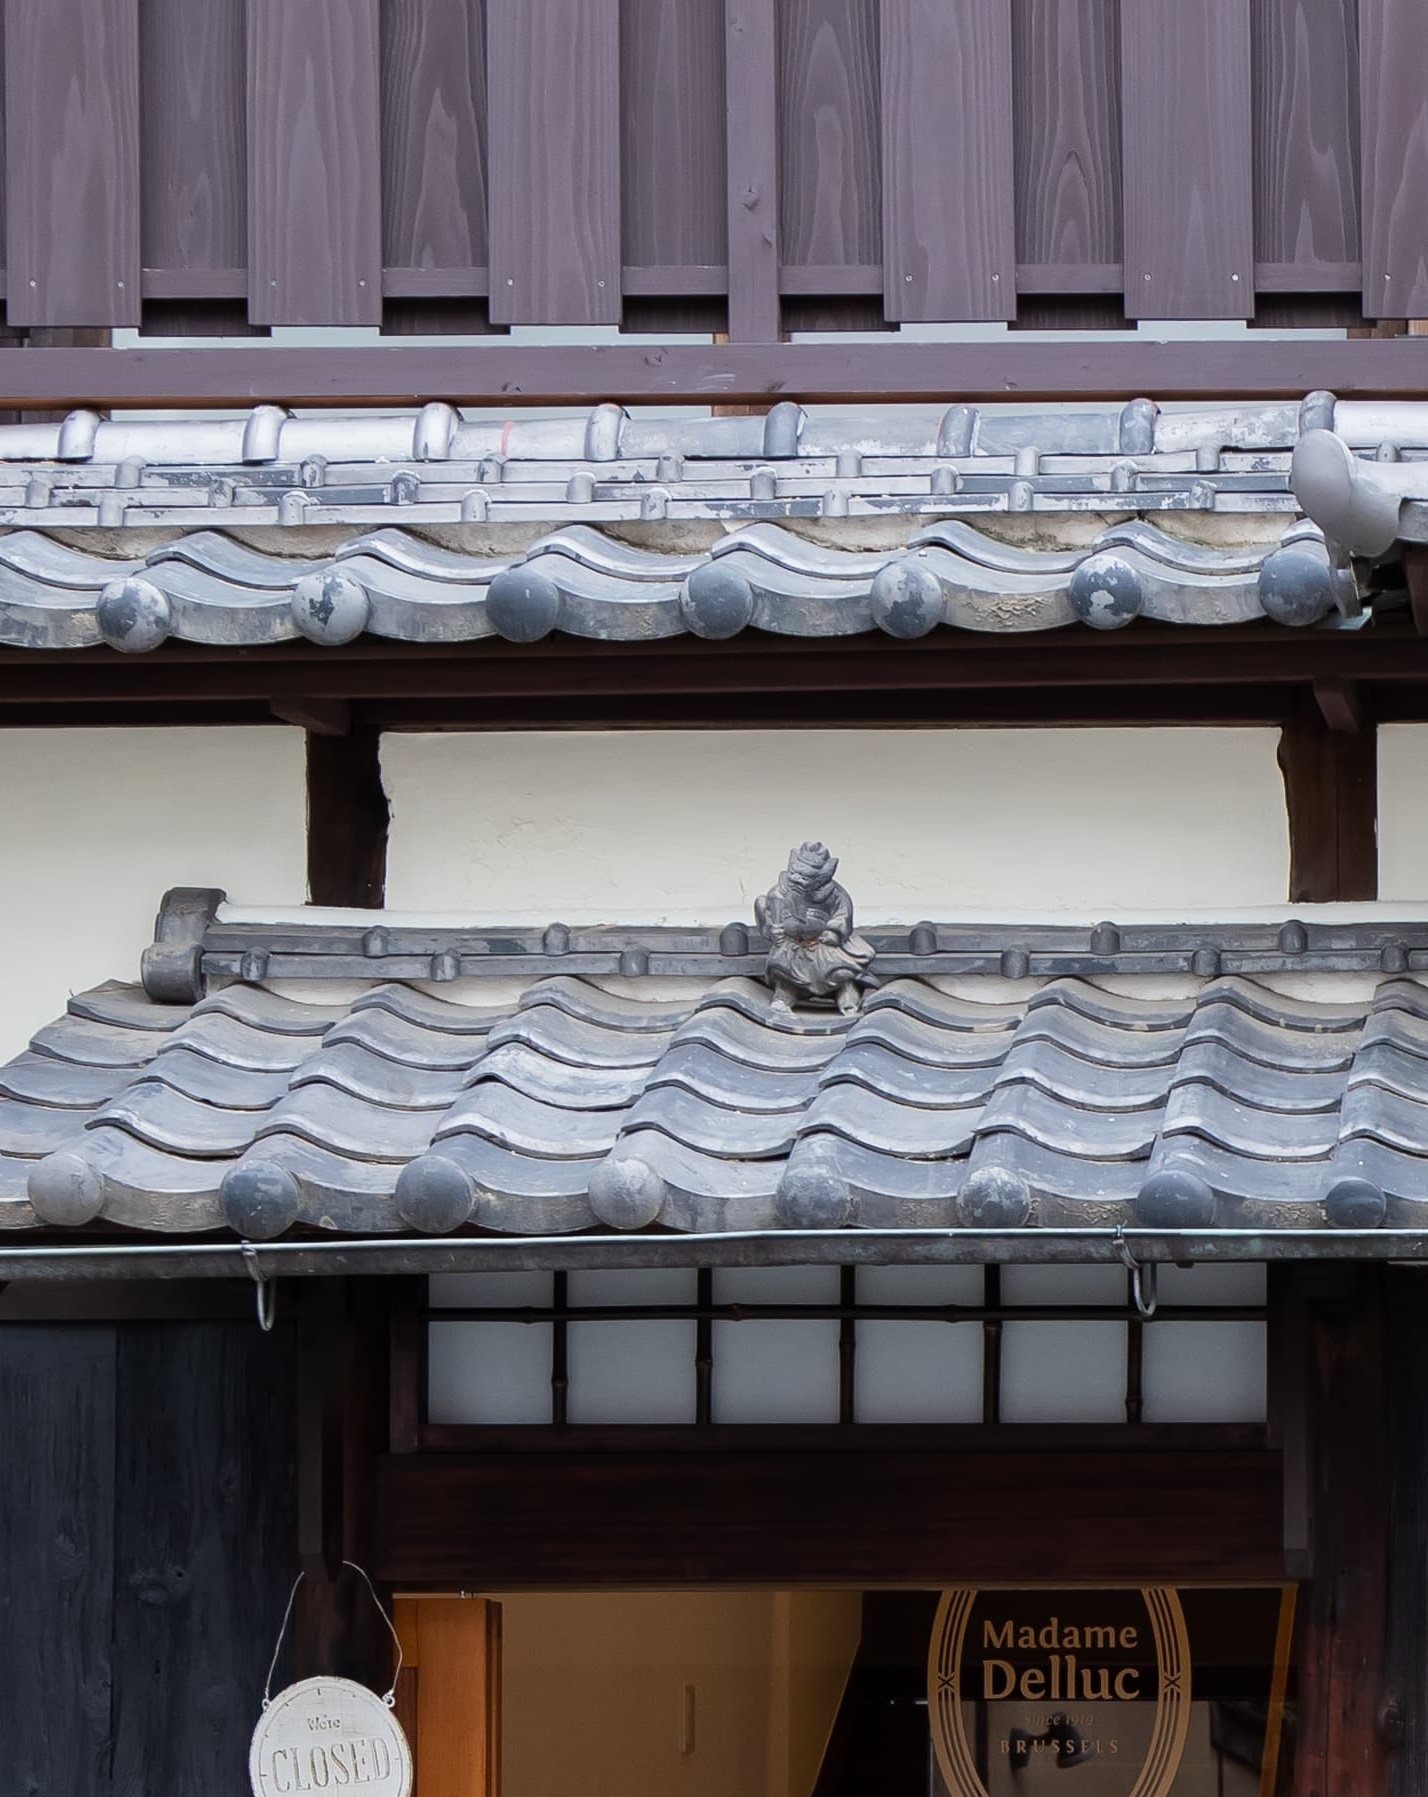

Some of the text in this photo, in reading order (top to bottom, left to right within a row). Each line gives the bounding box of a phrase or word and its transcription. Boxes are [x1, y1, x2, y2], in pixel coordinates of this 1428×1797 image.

[983, 1617, 1138, 1649] Madame
[982, 1655, 1140, 1700] Delluc
[1026, 1713, 1061, 1727] Since
[1001, 1739, 1119, 1753] BRUSSELS
[271, 1737, 391, 1793] CLOSED
